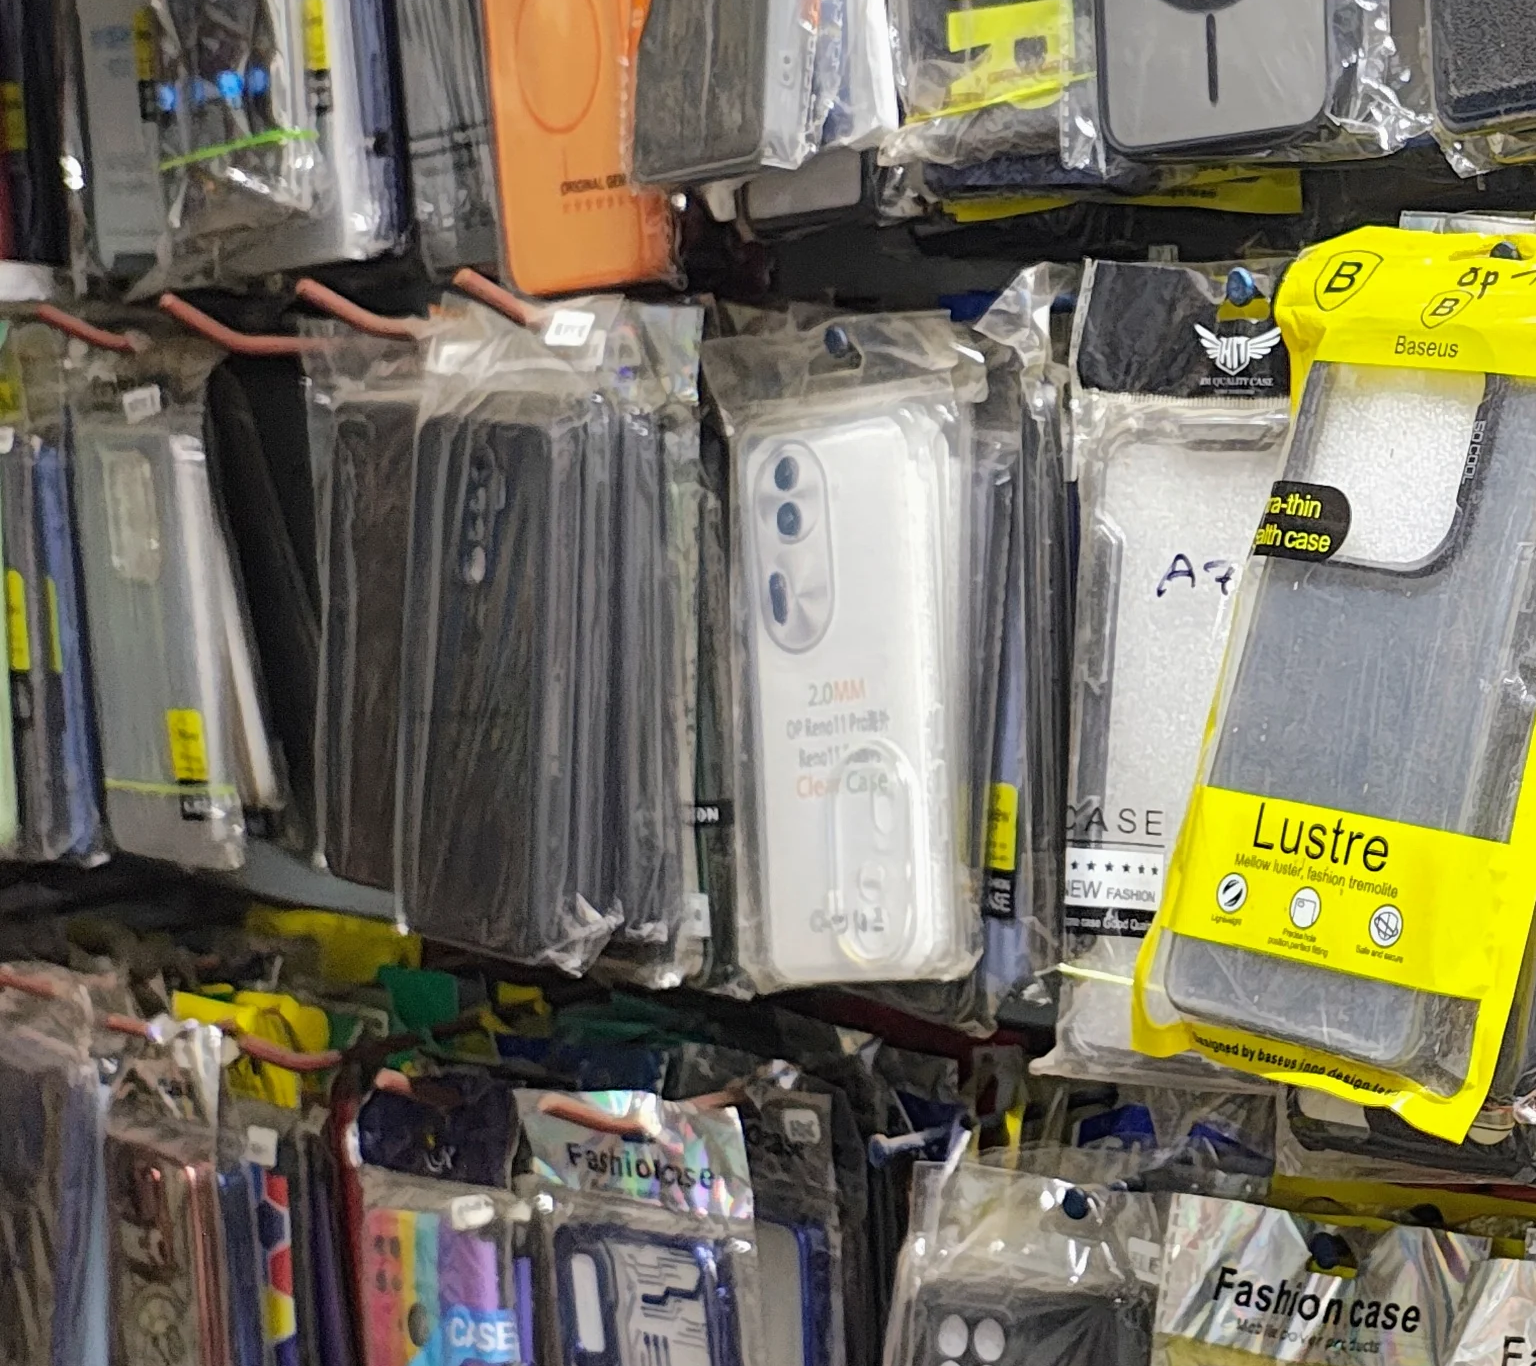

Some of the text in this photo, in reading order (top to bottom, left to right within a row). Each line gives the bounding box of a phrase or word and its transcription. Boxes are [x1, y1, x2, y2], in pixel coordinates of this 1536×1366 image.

[1394, 334, 1459, 359] Baseus
[1250, 377, 1273, 386] CASE
[1284, 530, 1331, 552] case
[1253, 803, 1389, 872] Lustre
[1234, 852, 1270, 871] Mellow
[1307, 866, 1346, 888] fashion
[1349, 875, 1398, 899] tremolite
[1106, 887, 1156, 903] FASHION
[1242, 1043, 1255, 1062] by
[1212, 1266, 1422, 1333] Fashion case
